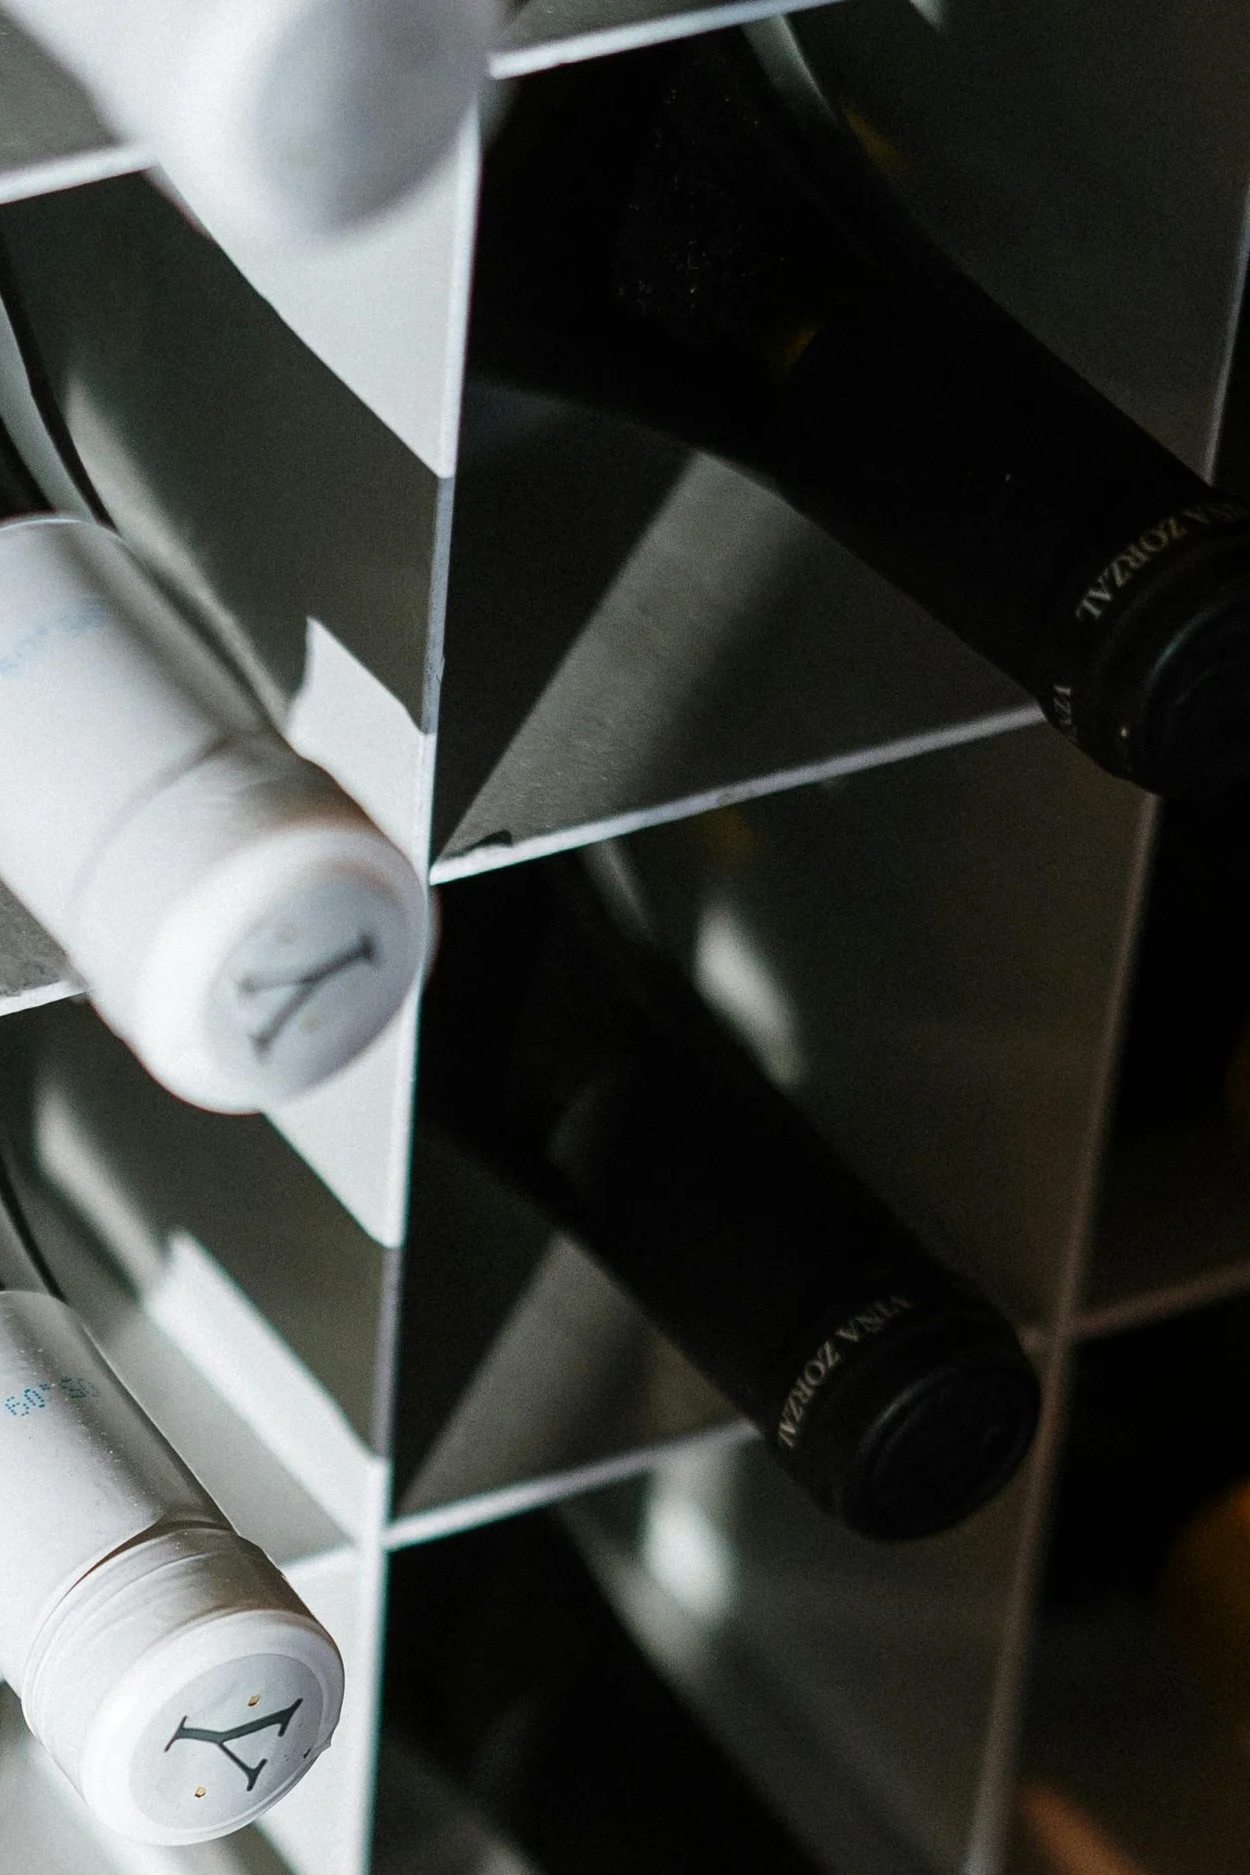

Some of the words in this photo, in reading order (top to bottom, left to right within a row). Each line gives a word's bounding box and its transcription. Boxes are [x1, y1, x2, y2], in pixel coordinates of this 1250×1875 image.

[1073, 515, 1187, 620] ZORZAL
[236, 930, 378, 1064] Y
[164, 1697, 303, 1792] Y
